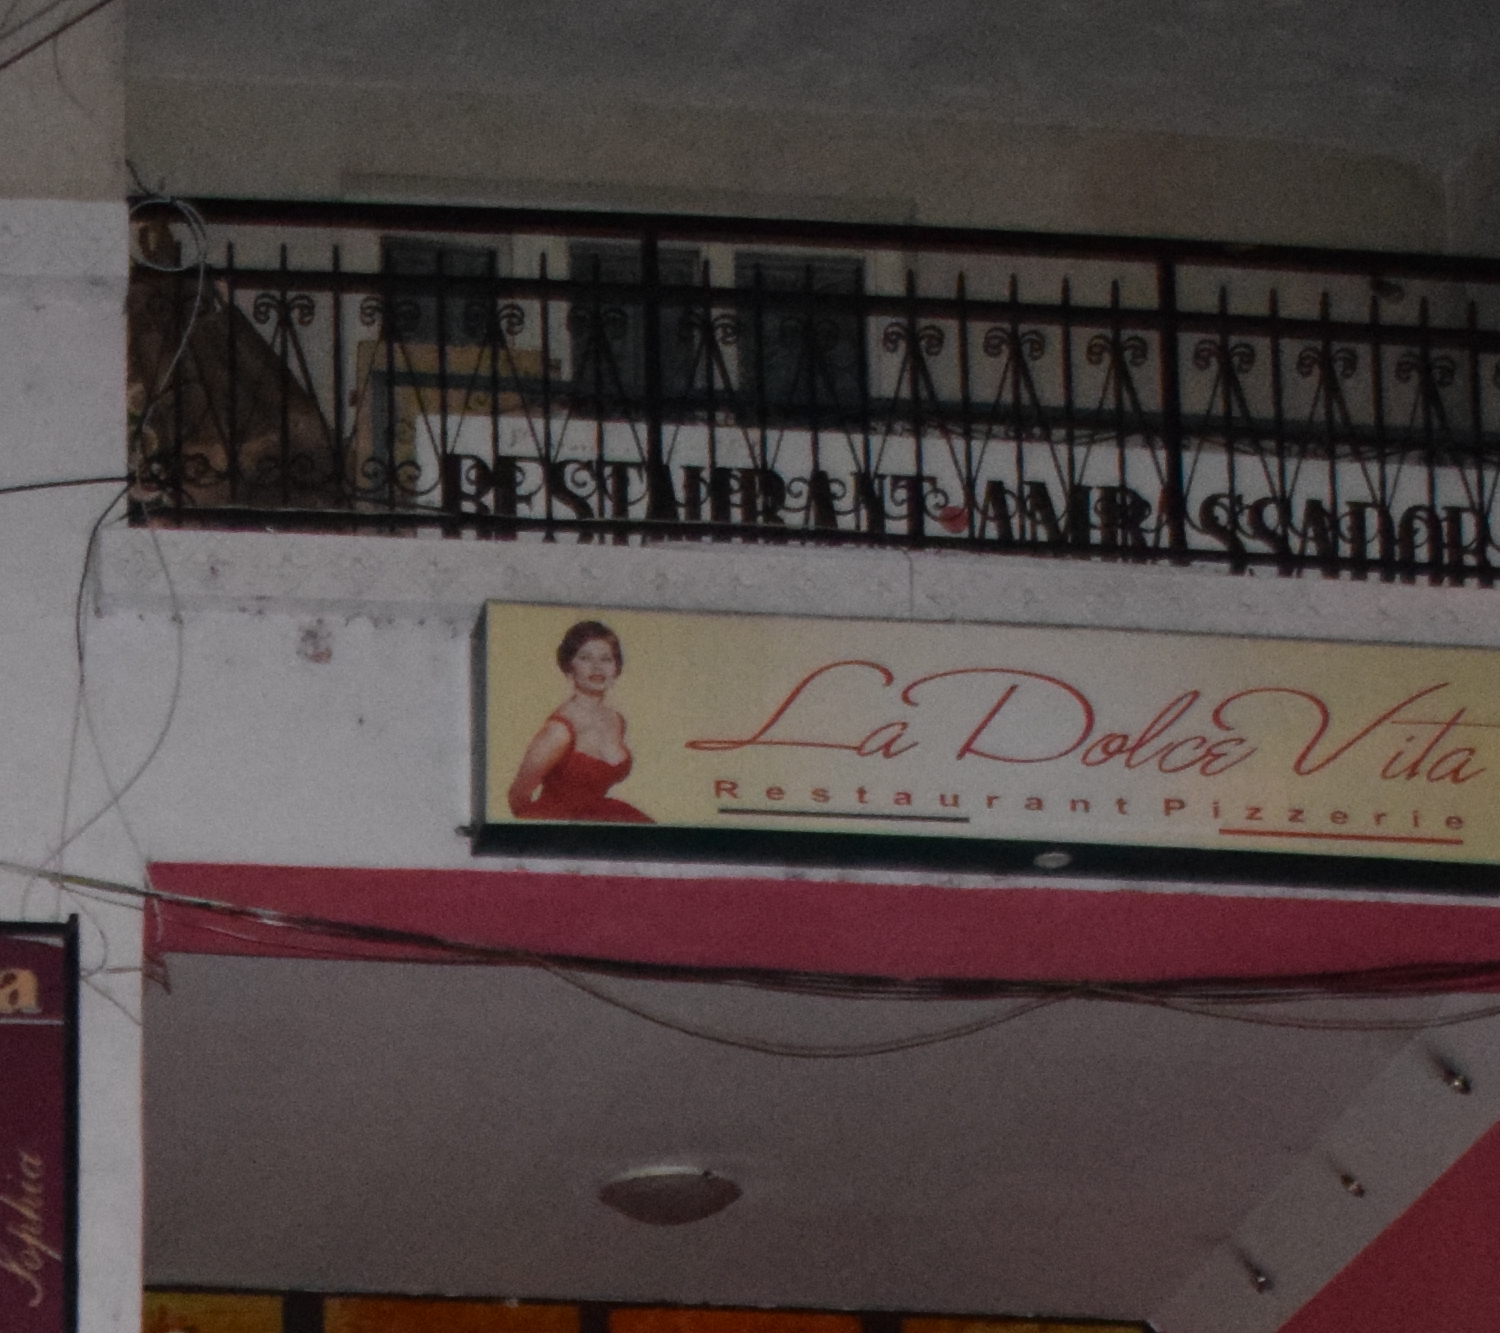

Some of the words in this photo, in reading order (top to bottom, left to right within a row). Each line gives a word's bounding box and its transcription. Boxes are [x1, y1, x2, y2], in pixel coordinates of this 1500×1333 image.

[685, 659, 918, 760] La
[900, 667, 1257, 777] Dolce
[714, 778, 1130, 817] Restaurant
[1164, 797, 1466, 832] Pizzerie
